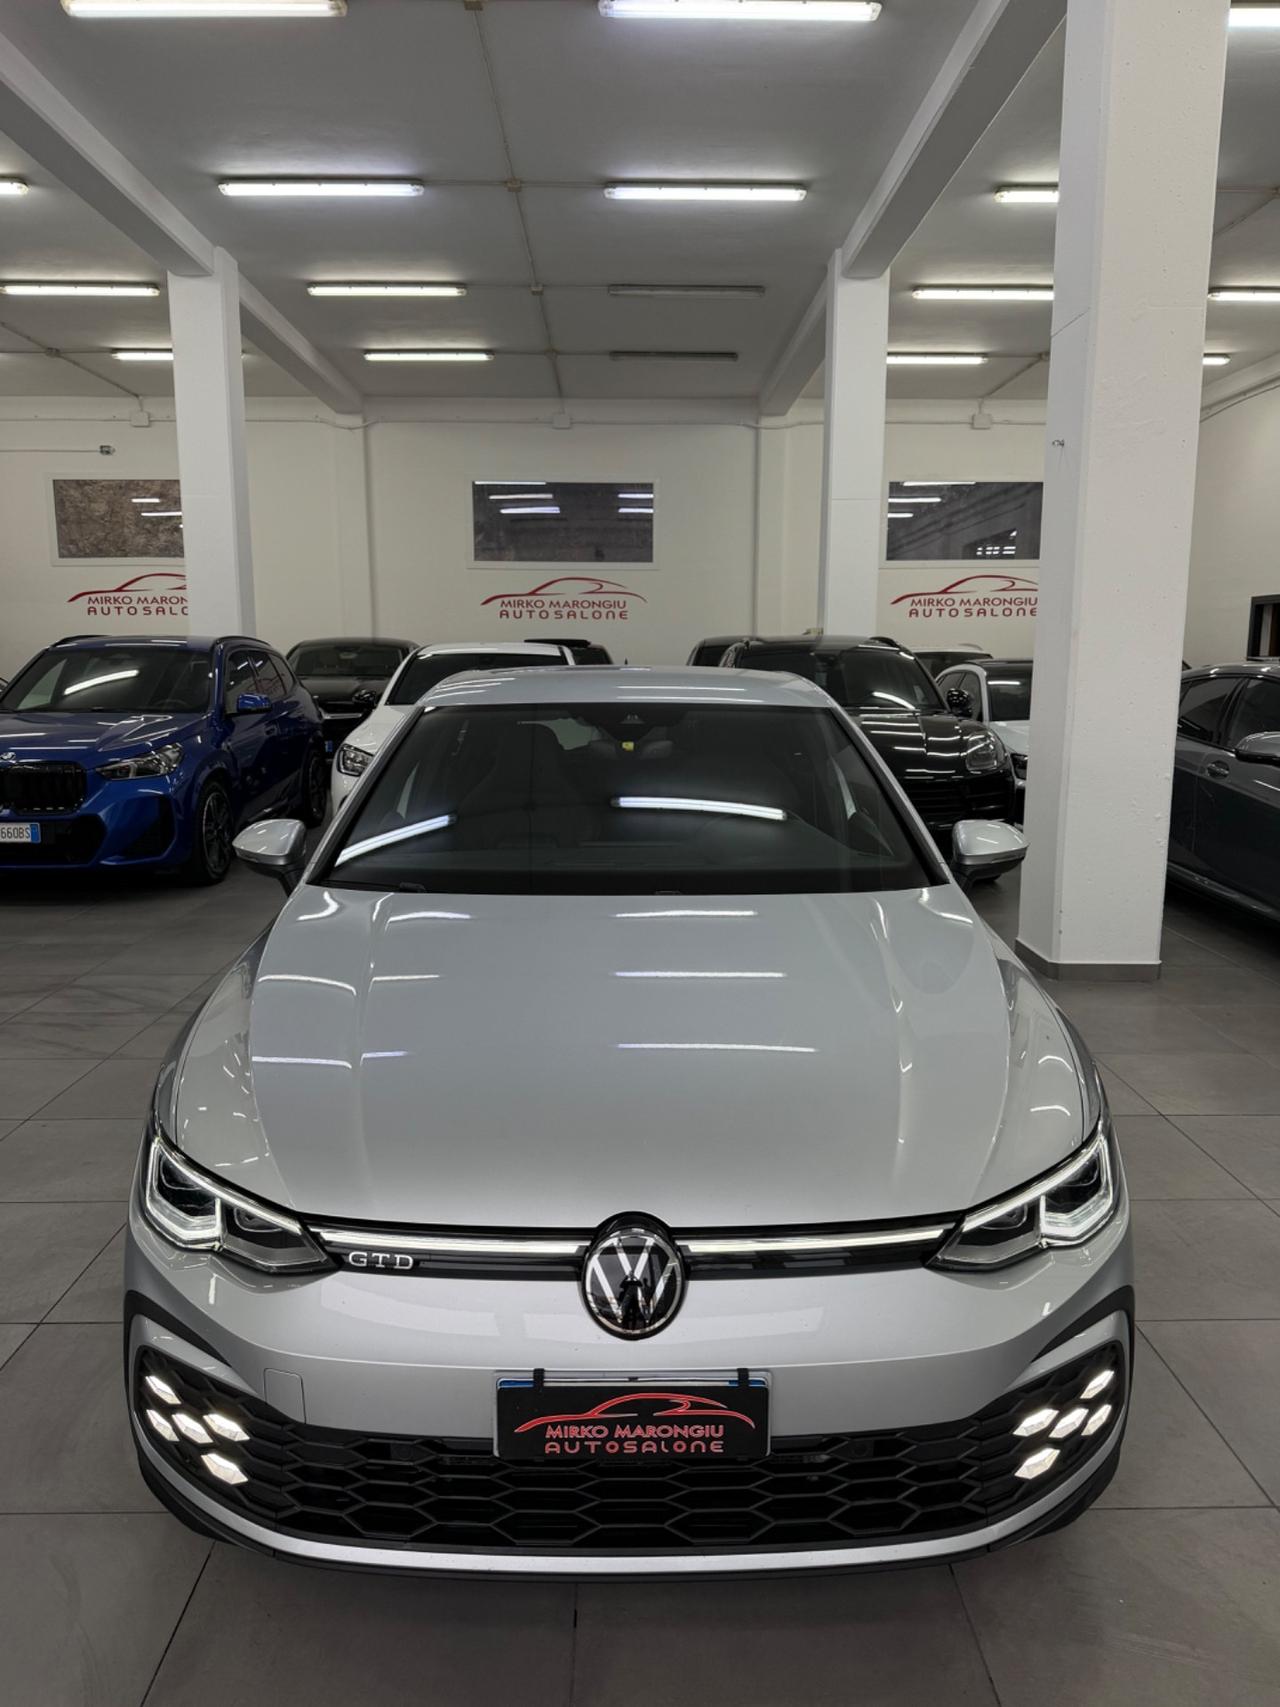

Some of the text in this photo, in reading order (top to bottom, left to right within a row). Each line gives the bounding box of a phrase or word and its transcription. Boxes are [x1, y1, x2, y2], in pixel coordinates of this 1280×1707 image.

[87, 595, 133, 605] MIRKO
[500, 599, 627, 610] MIRKO MARONGIU
[910, 597, 1038, 607] MIRKO MARONGIU
[499, 610, 629, 620] AUTOSALONE
[908, 608, 1037, 618] AUTOSALONE
[349, 1251, 414, 1270] GTD
[545, 1424, 724, 1439] MIRKO MARONGIU
[545, 1440, 724, 1454] AUTOSALONE
